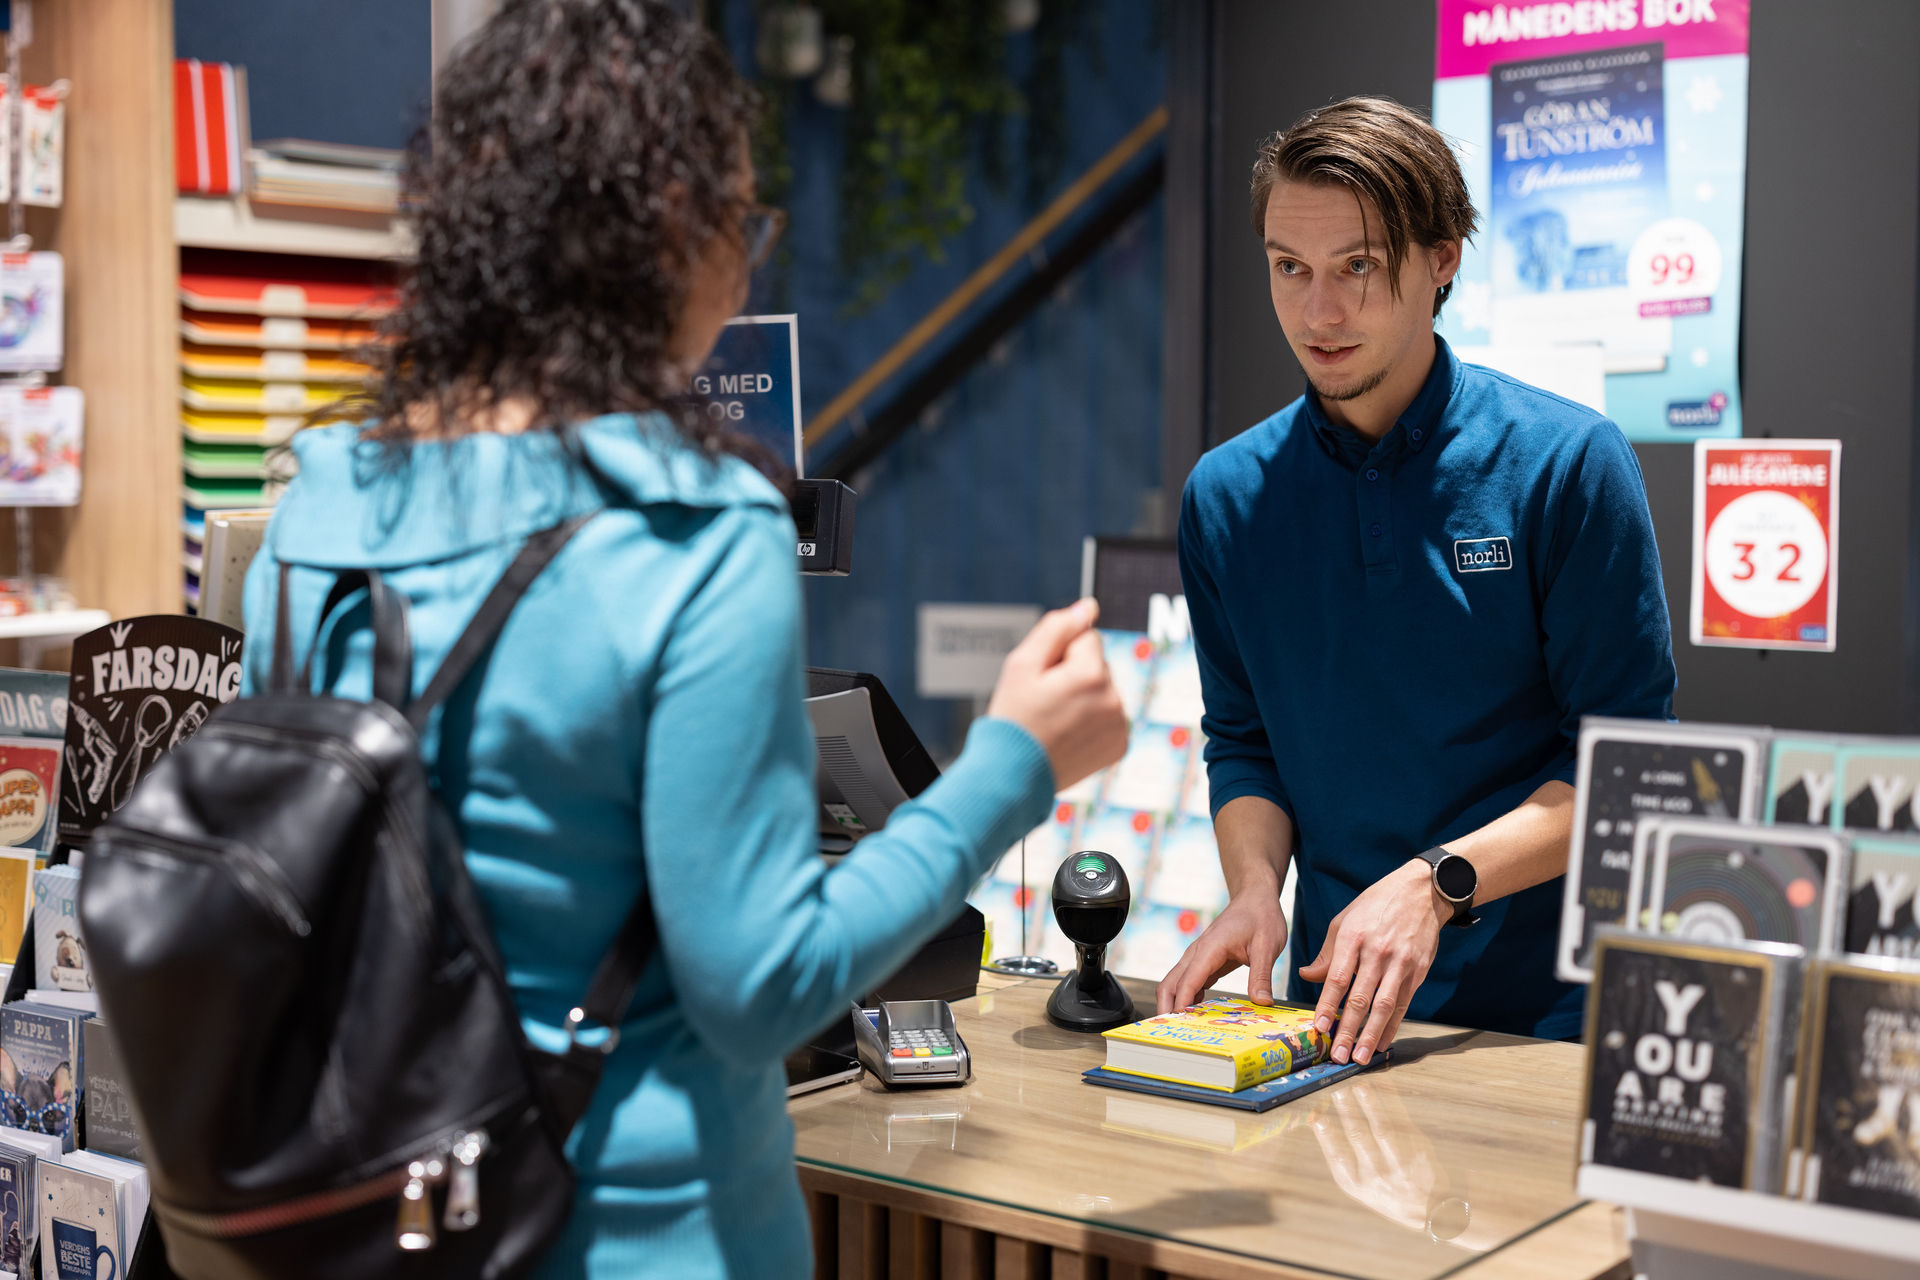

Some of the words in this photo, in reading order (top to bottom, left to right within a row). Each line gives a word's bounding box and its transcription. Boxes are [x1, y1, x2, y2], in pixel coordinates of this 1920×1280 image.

[1463, 0, 1639, 46] MÅNEDENS
[1643, 0, 1717, 28] BOK
[1523, 97, 1611, 131] GÖRAN
[1497, 115, 1655, 162] TUNSTRÖM
[1650, 252, 1694, 285] 99
[719, 374, 773, 394] MED
[1461, 544, 1506, 565] norli
[1732, 543, 1755, 580] 3
[1777, 543, 1801, 581] 2
[92, 645, 243, 704] FARSDAG
[0, 691, 49, 730] DAG
[1803, 770, 1835, 825] Y
[1654, 979, 1705, 1036] Y
[14, 1019, 52, 1041] PAPPA
[1261, 1047, 1287, 1067] TURBO-
[1634, 1033, 1714, 1082] OU
[90, 1090, 135, 1125] PAP
[1615, 1070, 1727, 1114] ARE
[59, 1239, 91, 1256] VERDENS
[60, 1249, 92, 1270] BESTE
[61, 1263, 92, 1277] BONUSPAPPA
